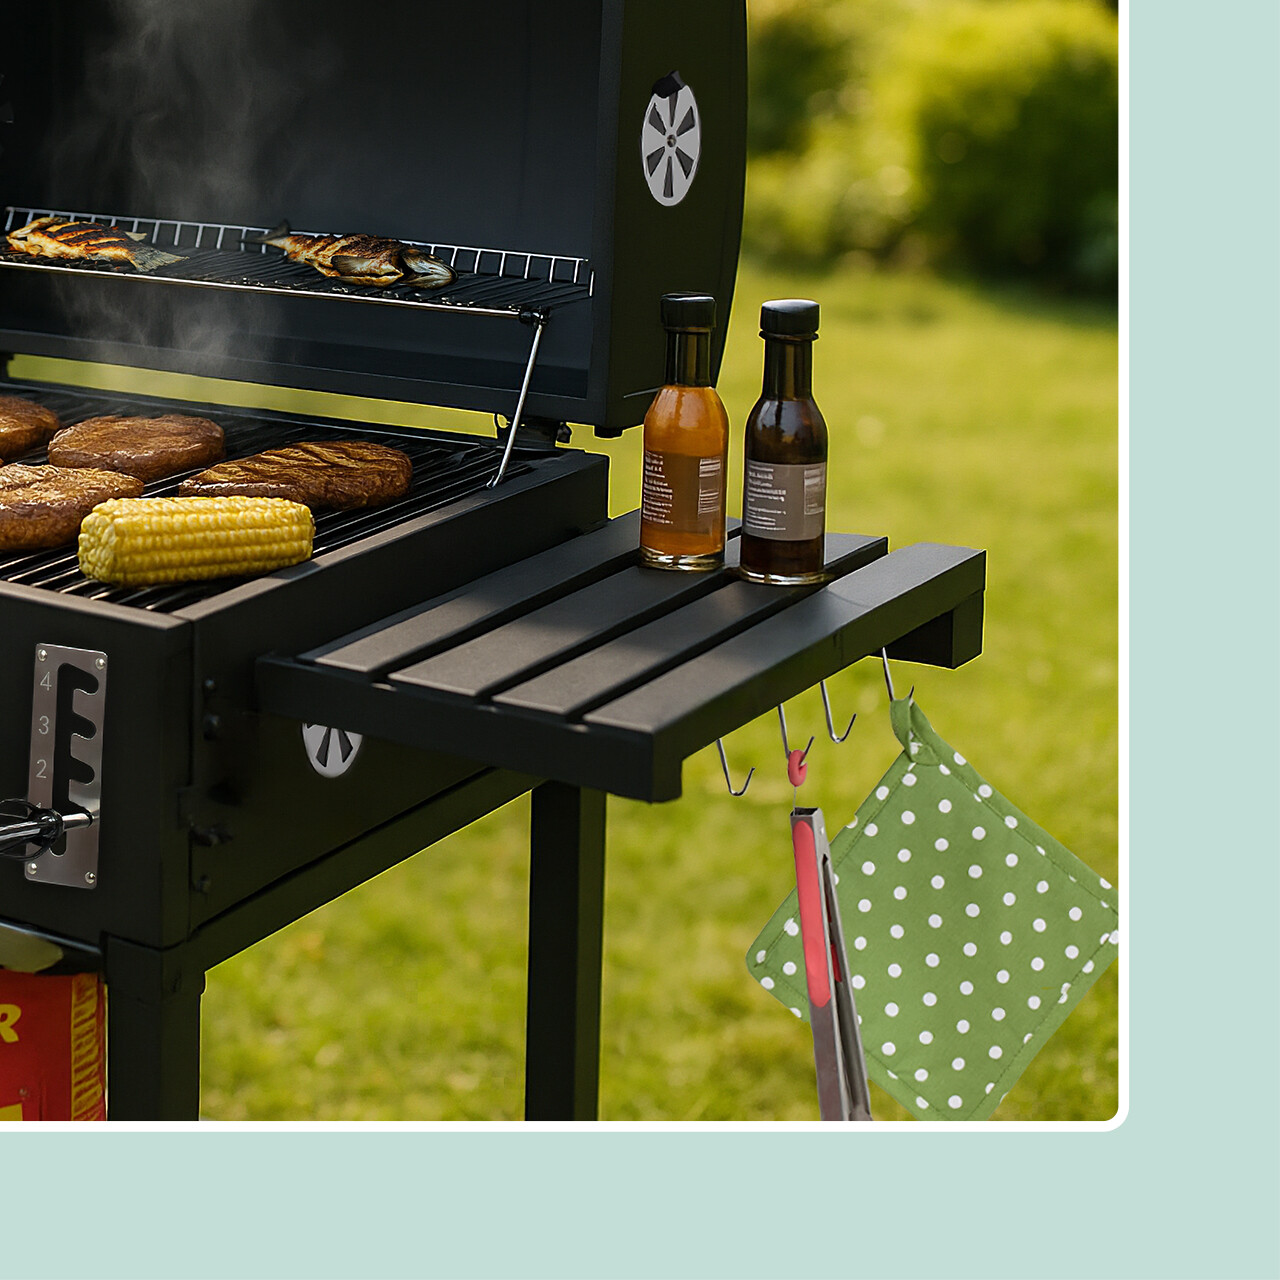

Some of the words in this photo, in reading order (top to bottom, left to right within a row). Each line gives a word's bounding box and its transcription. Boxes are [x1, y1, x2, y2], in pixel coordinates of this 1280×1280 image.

[39, 671, 52, 691] 4
[38, 715, 50, 735] 3
[35, 758, 47, 779] 2
